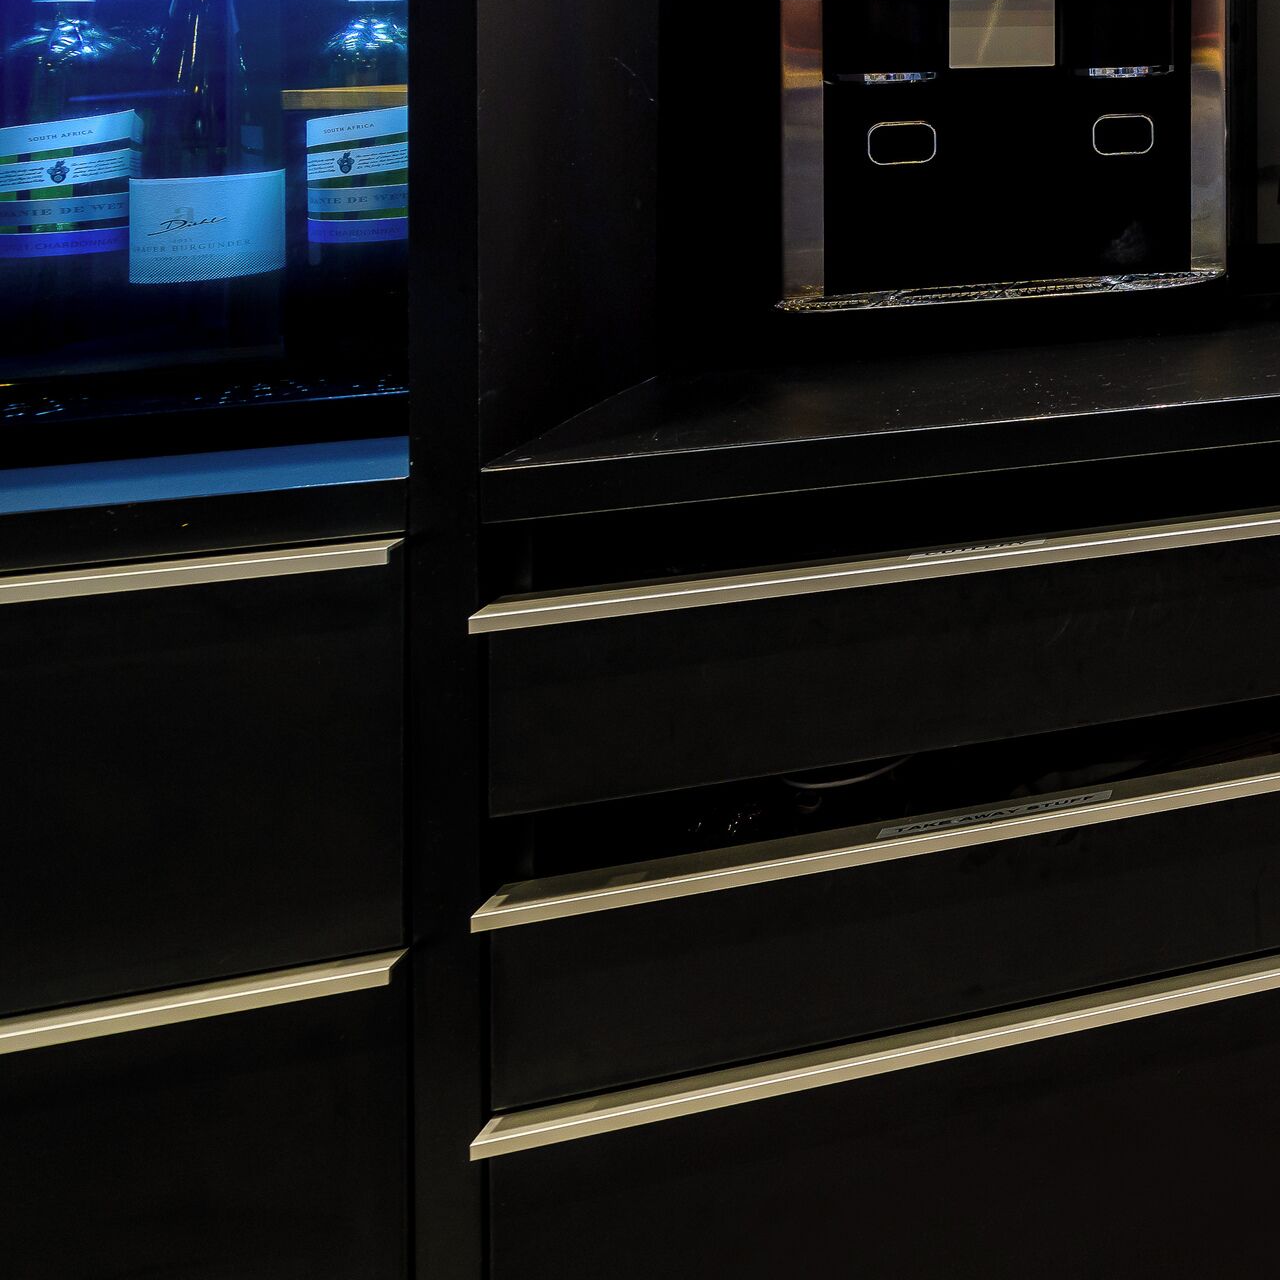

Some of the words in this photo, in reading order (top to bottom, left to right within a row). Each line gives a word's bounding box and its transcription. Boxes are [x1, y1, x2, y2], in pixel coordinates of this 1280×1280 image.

[323, 126, 345, 134] SOUTH
[347, 122, 375, 131] AFRICA
[28, 133, 58, 143] SOUTH
[60, 129, 94, 138] AFRICA
[348, 196, 368, 204] DE
[60, 206, 85, 216] DE
[88, 202, 125, 212] WET
[172, 240, 251, 252] BURGUNDER
[897, 820, 953, 833] TAKE
[959, 808, 1020, 822] AWAY
[1026, 794, 1096, 810] STUFF
